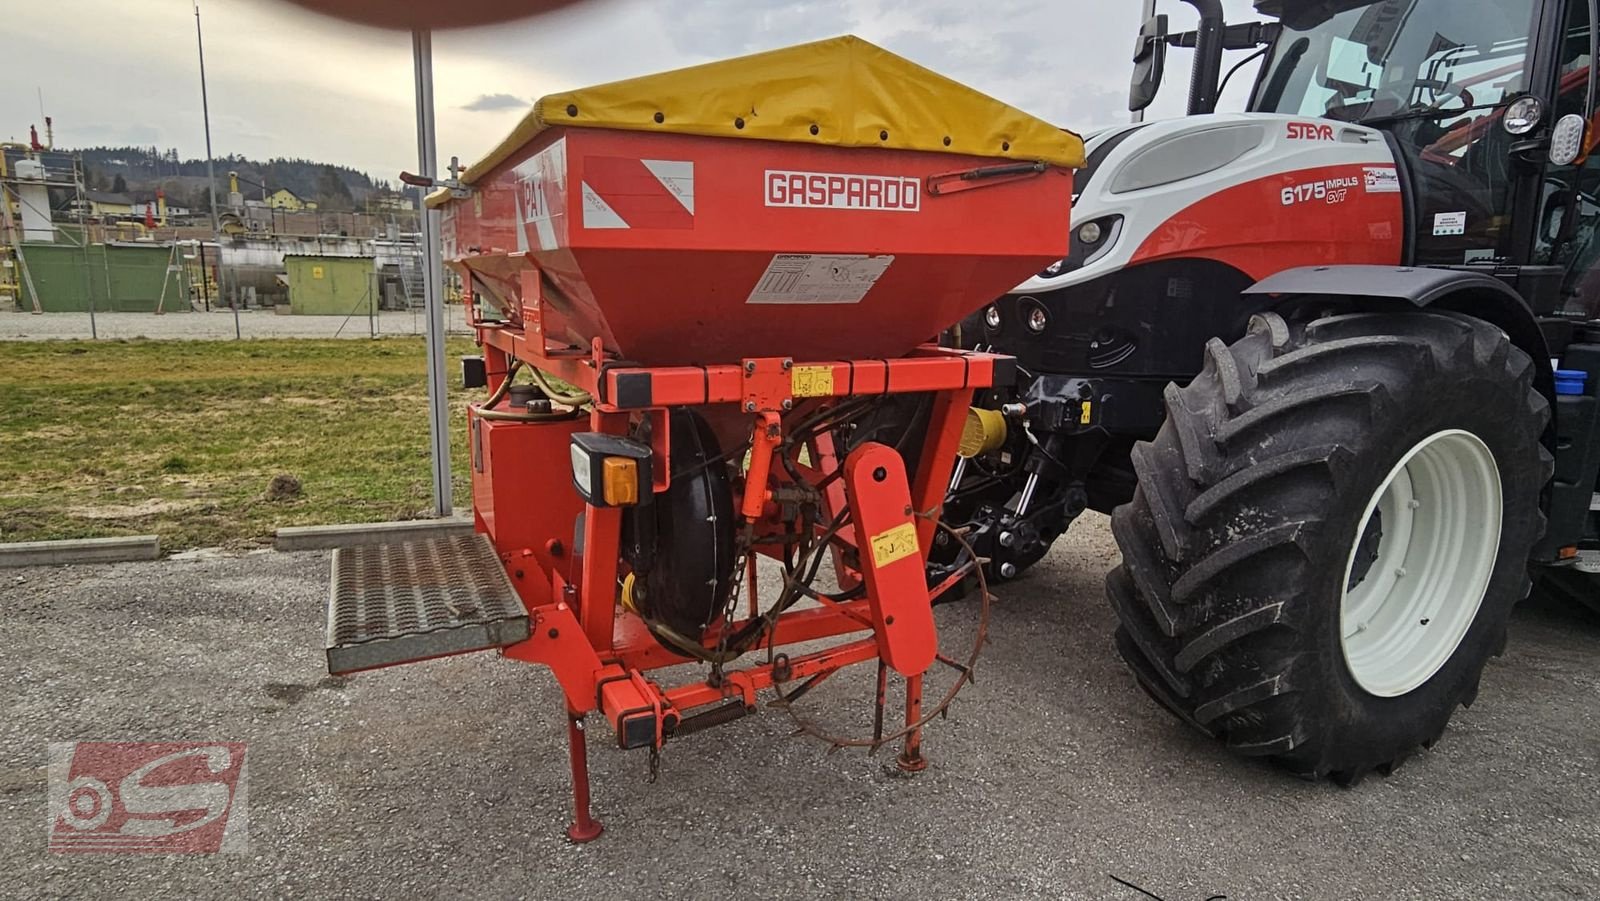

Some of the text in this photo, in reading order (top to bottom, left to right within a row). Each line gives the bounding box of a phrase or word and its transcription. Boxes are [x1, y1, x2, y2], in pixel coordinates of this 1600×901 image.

[1286, 122, 1334, 141] STEYR
[768, 173, 918, 209] GASPARDO
[1281, 177, 1358, 206] 6175 IMPULS
[1326, 188, 1347, 204] CVT
